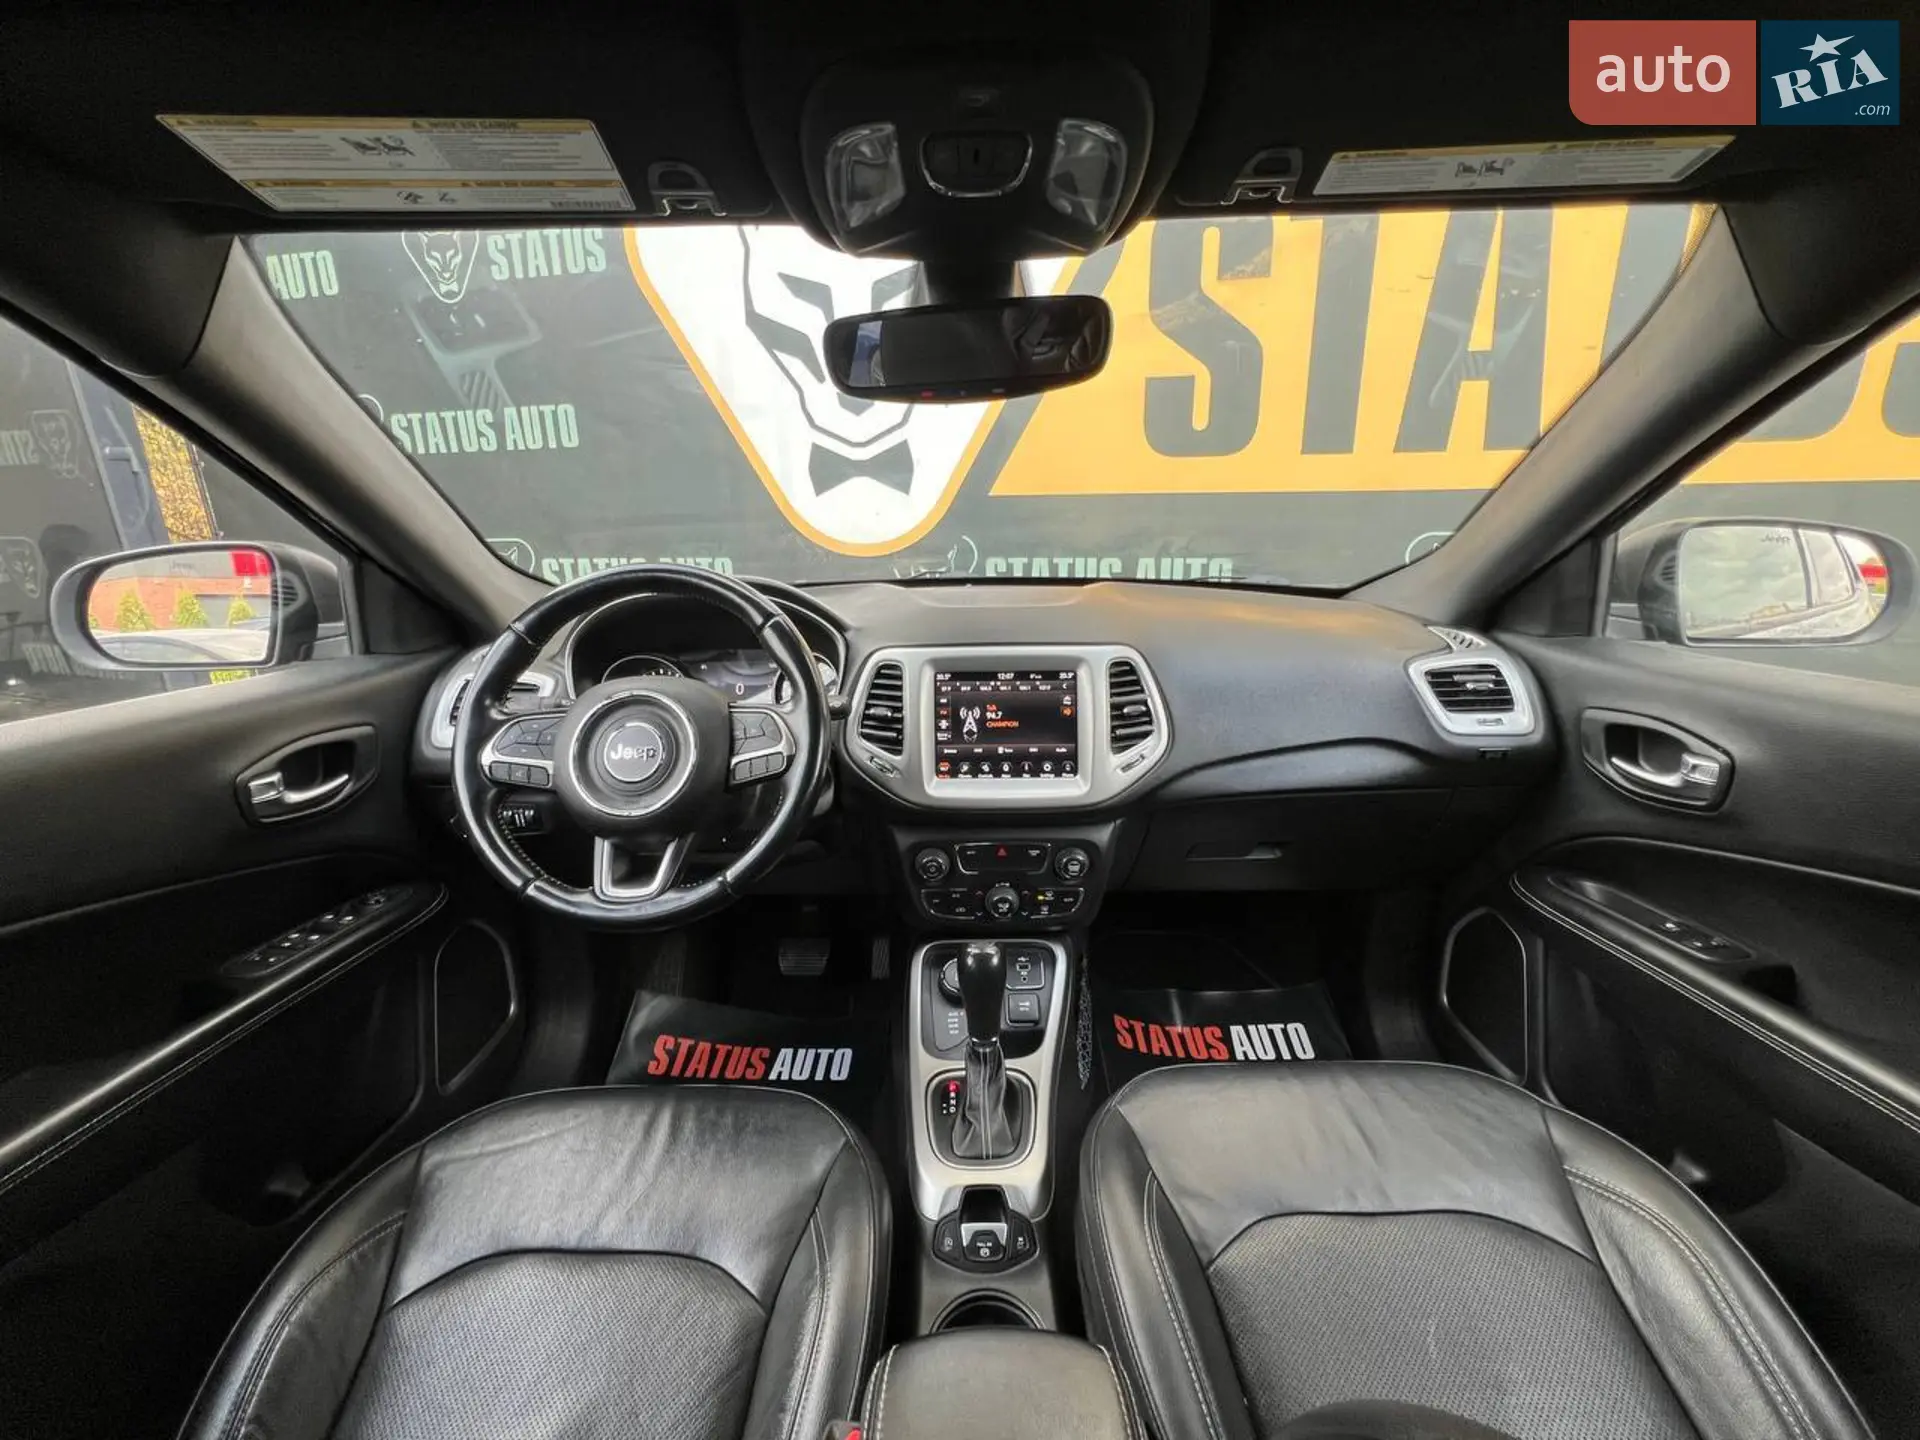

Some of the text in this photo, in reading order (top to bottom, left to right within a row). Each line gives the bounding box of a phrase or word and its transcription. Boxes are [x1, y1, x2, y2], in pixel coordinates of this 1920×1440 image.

[266, 249, 339, 300] AUTO
[486, 227, 607, 281] STATUS
[390, 403, 580, 455] STATUS AUTO
[610, 743, 657, 763] Jeep
[647, 1034, 853, 1082] STATUS AUTO
[1113, 1013, 1316, 1061] STATUS AUTO
